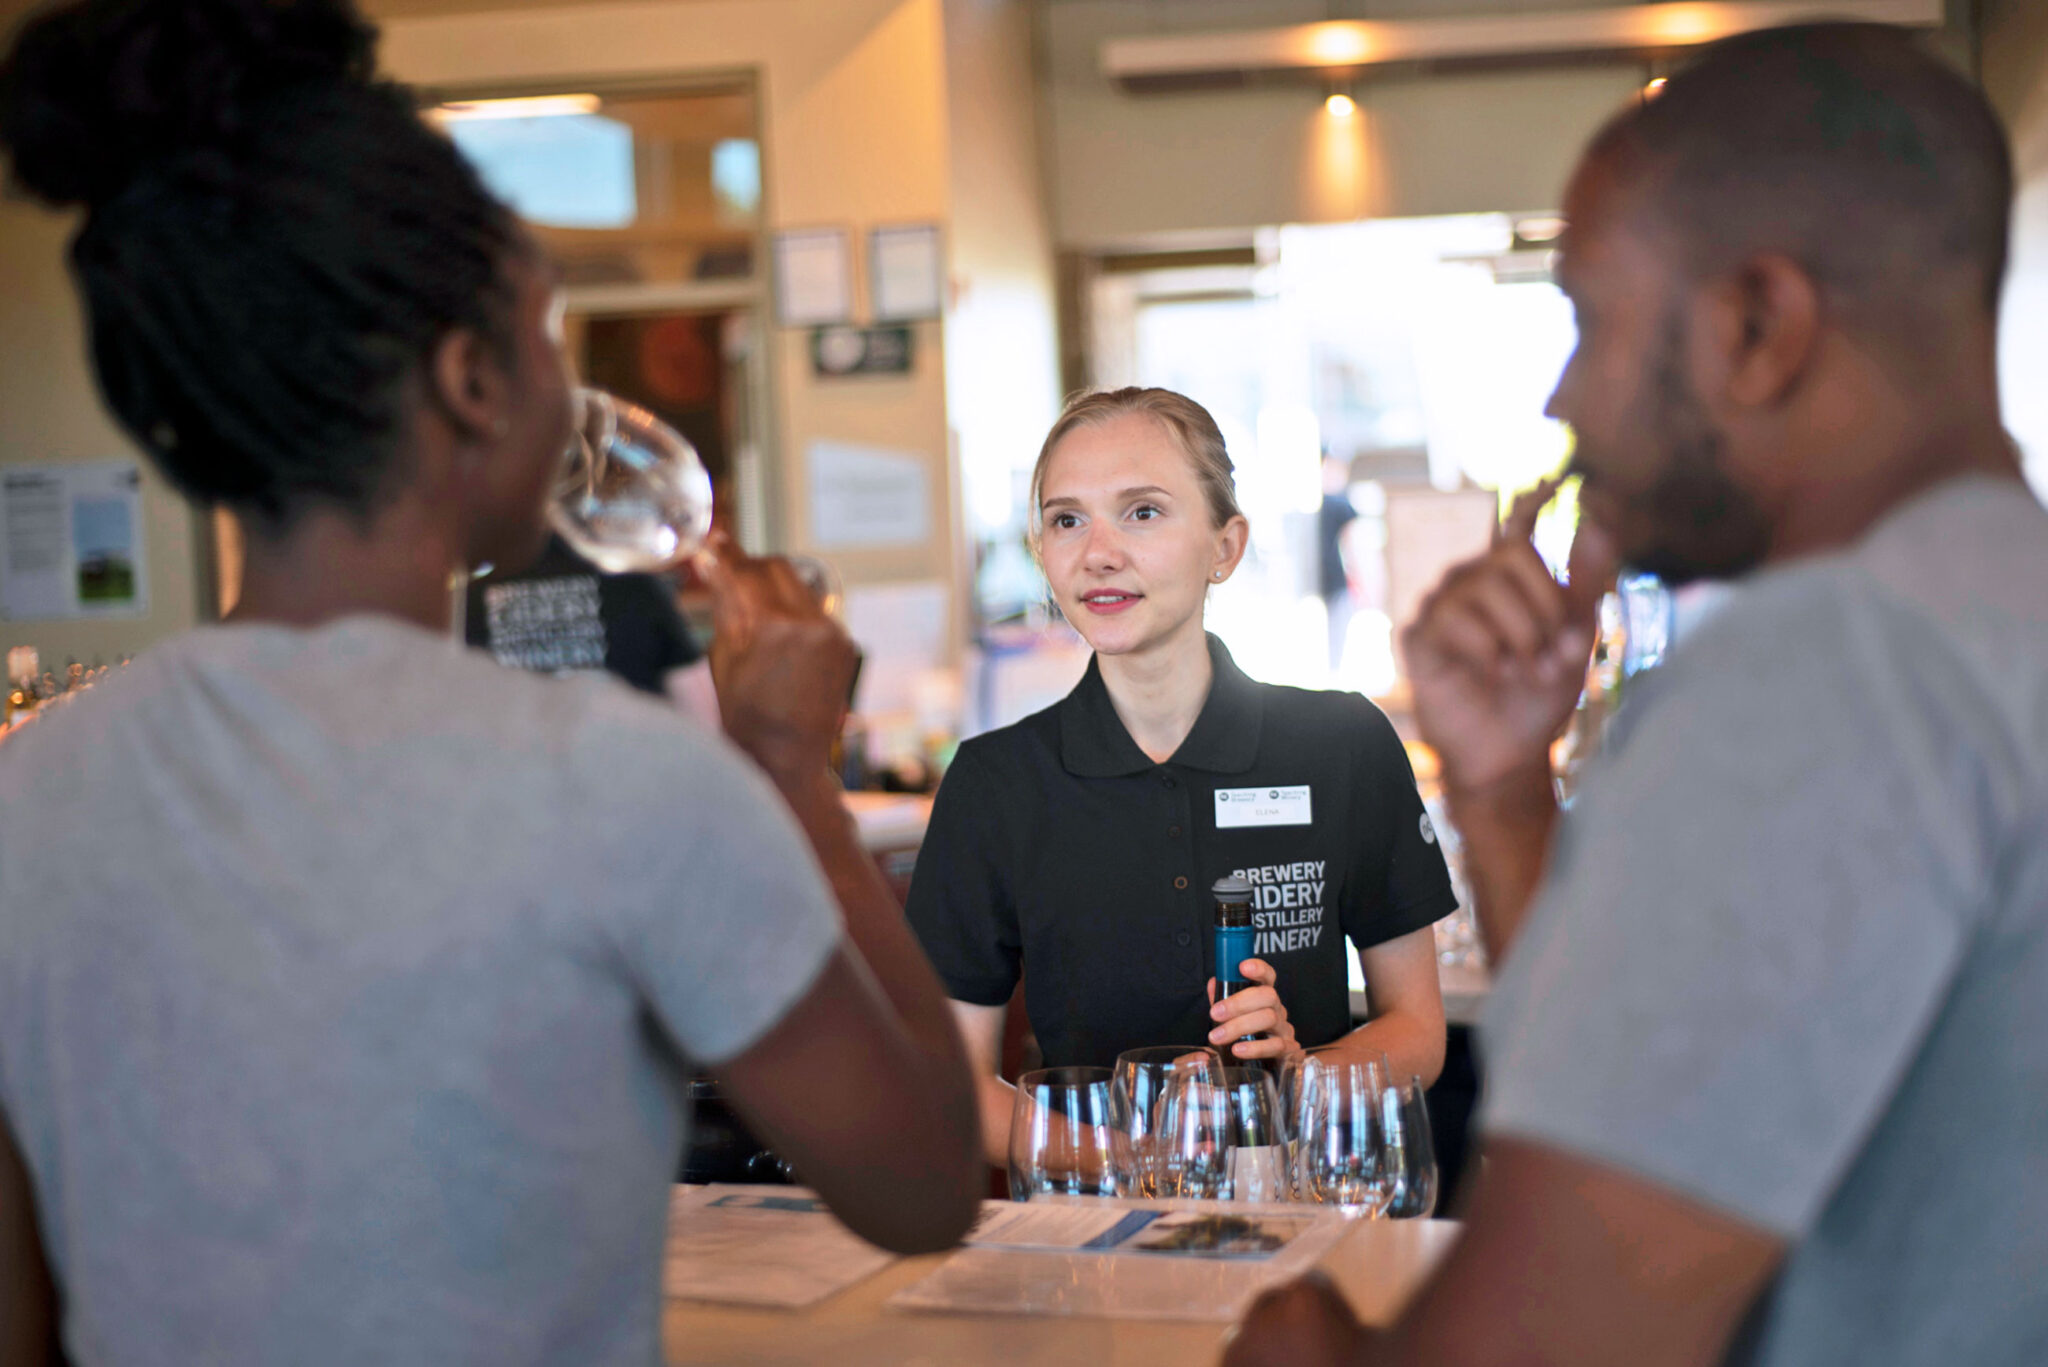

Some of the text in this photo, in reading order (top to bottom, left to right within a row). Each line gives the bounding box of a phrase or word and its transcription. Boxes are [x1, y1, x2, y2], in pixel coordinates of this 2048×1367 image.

[1233, 860, 1325, 884] BREWERY
[1250, 881, 1325, 910] IDERY
[1251, 906, 1324, 928] ISTILLERY
